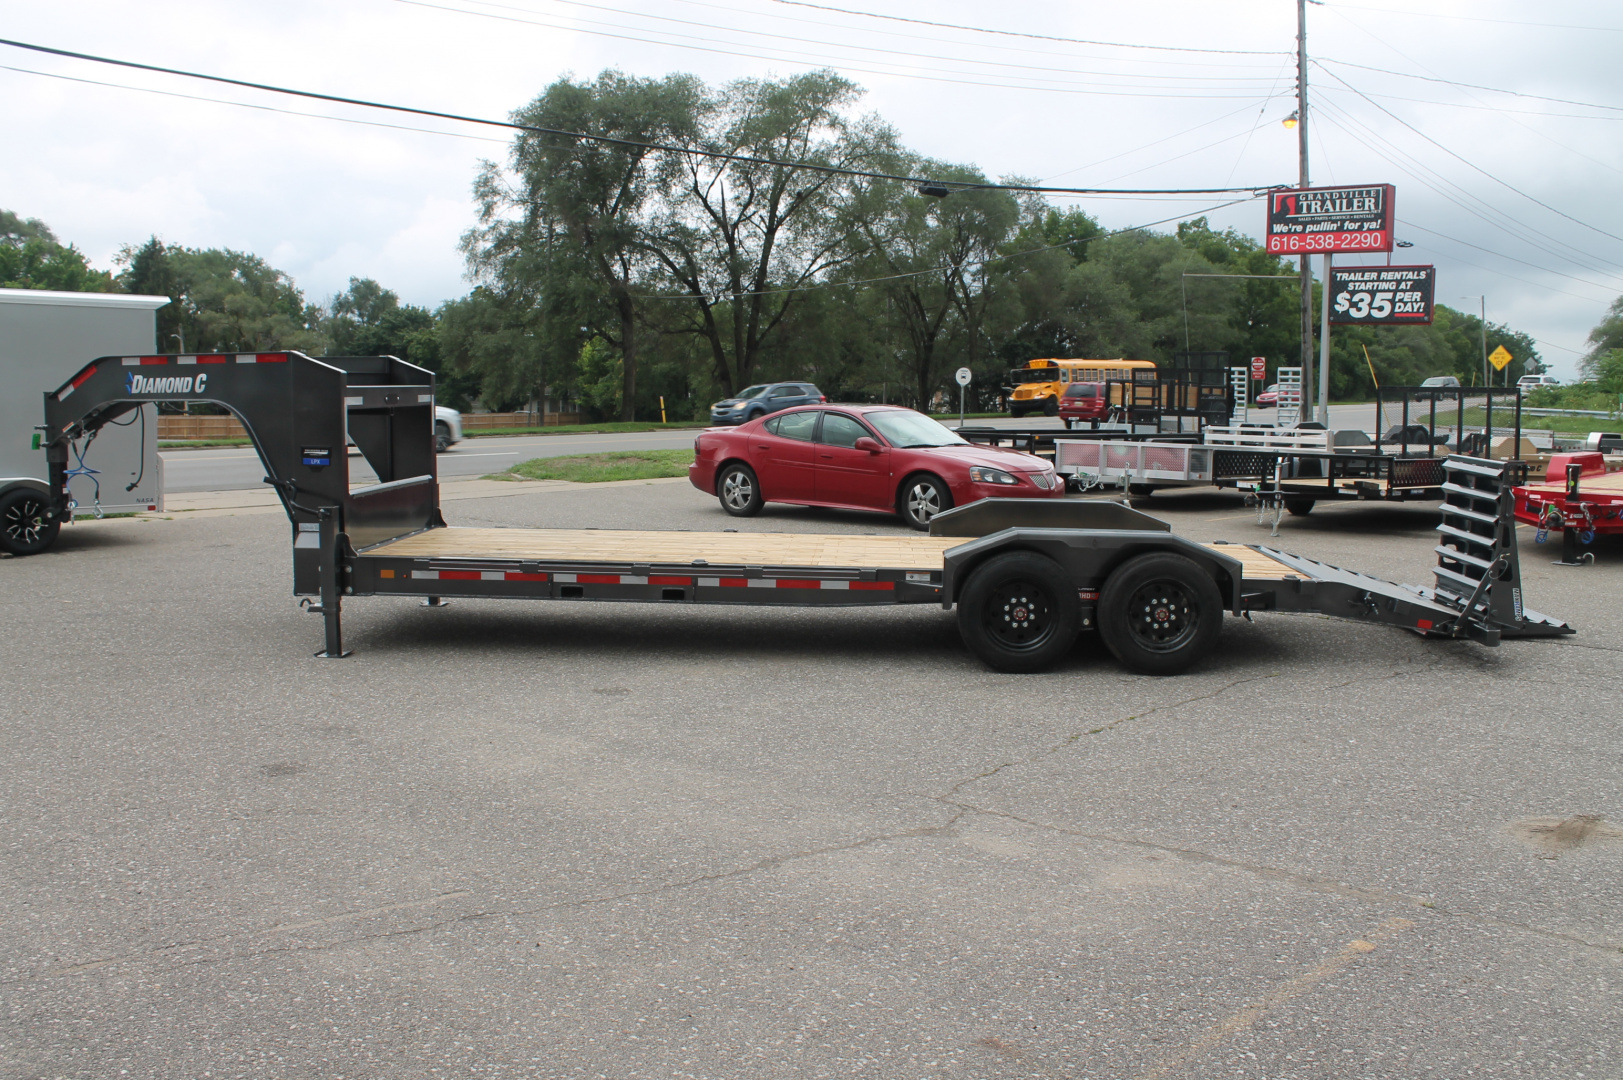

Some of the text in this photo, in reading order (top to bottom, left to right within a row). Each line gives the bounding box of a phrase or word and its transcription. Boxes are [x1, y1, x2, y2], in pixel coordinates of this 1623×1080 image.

[1299, 190, 1377, 201] GRANDVILLE
[1299, 197, 1376, 214] TRAILER
[1273, 219, 1382, 233] We're pullin' for ya!
[1271, 232, 1381, 251] 616-538-2290
[1336, 271, 1427, 281] TRAILER RENTALS
[1347, 281, 1414, 291] STARTING AT
[1395, 291, 1422, 302] PER
[1334, 290, 1394, 319] $35
[1394, 302, 1425, 313] DAY!
[131, 373, 207, 394] DIAMOND C
